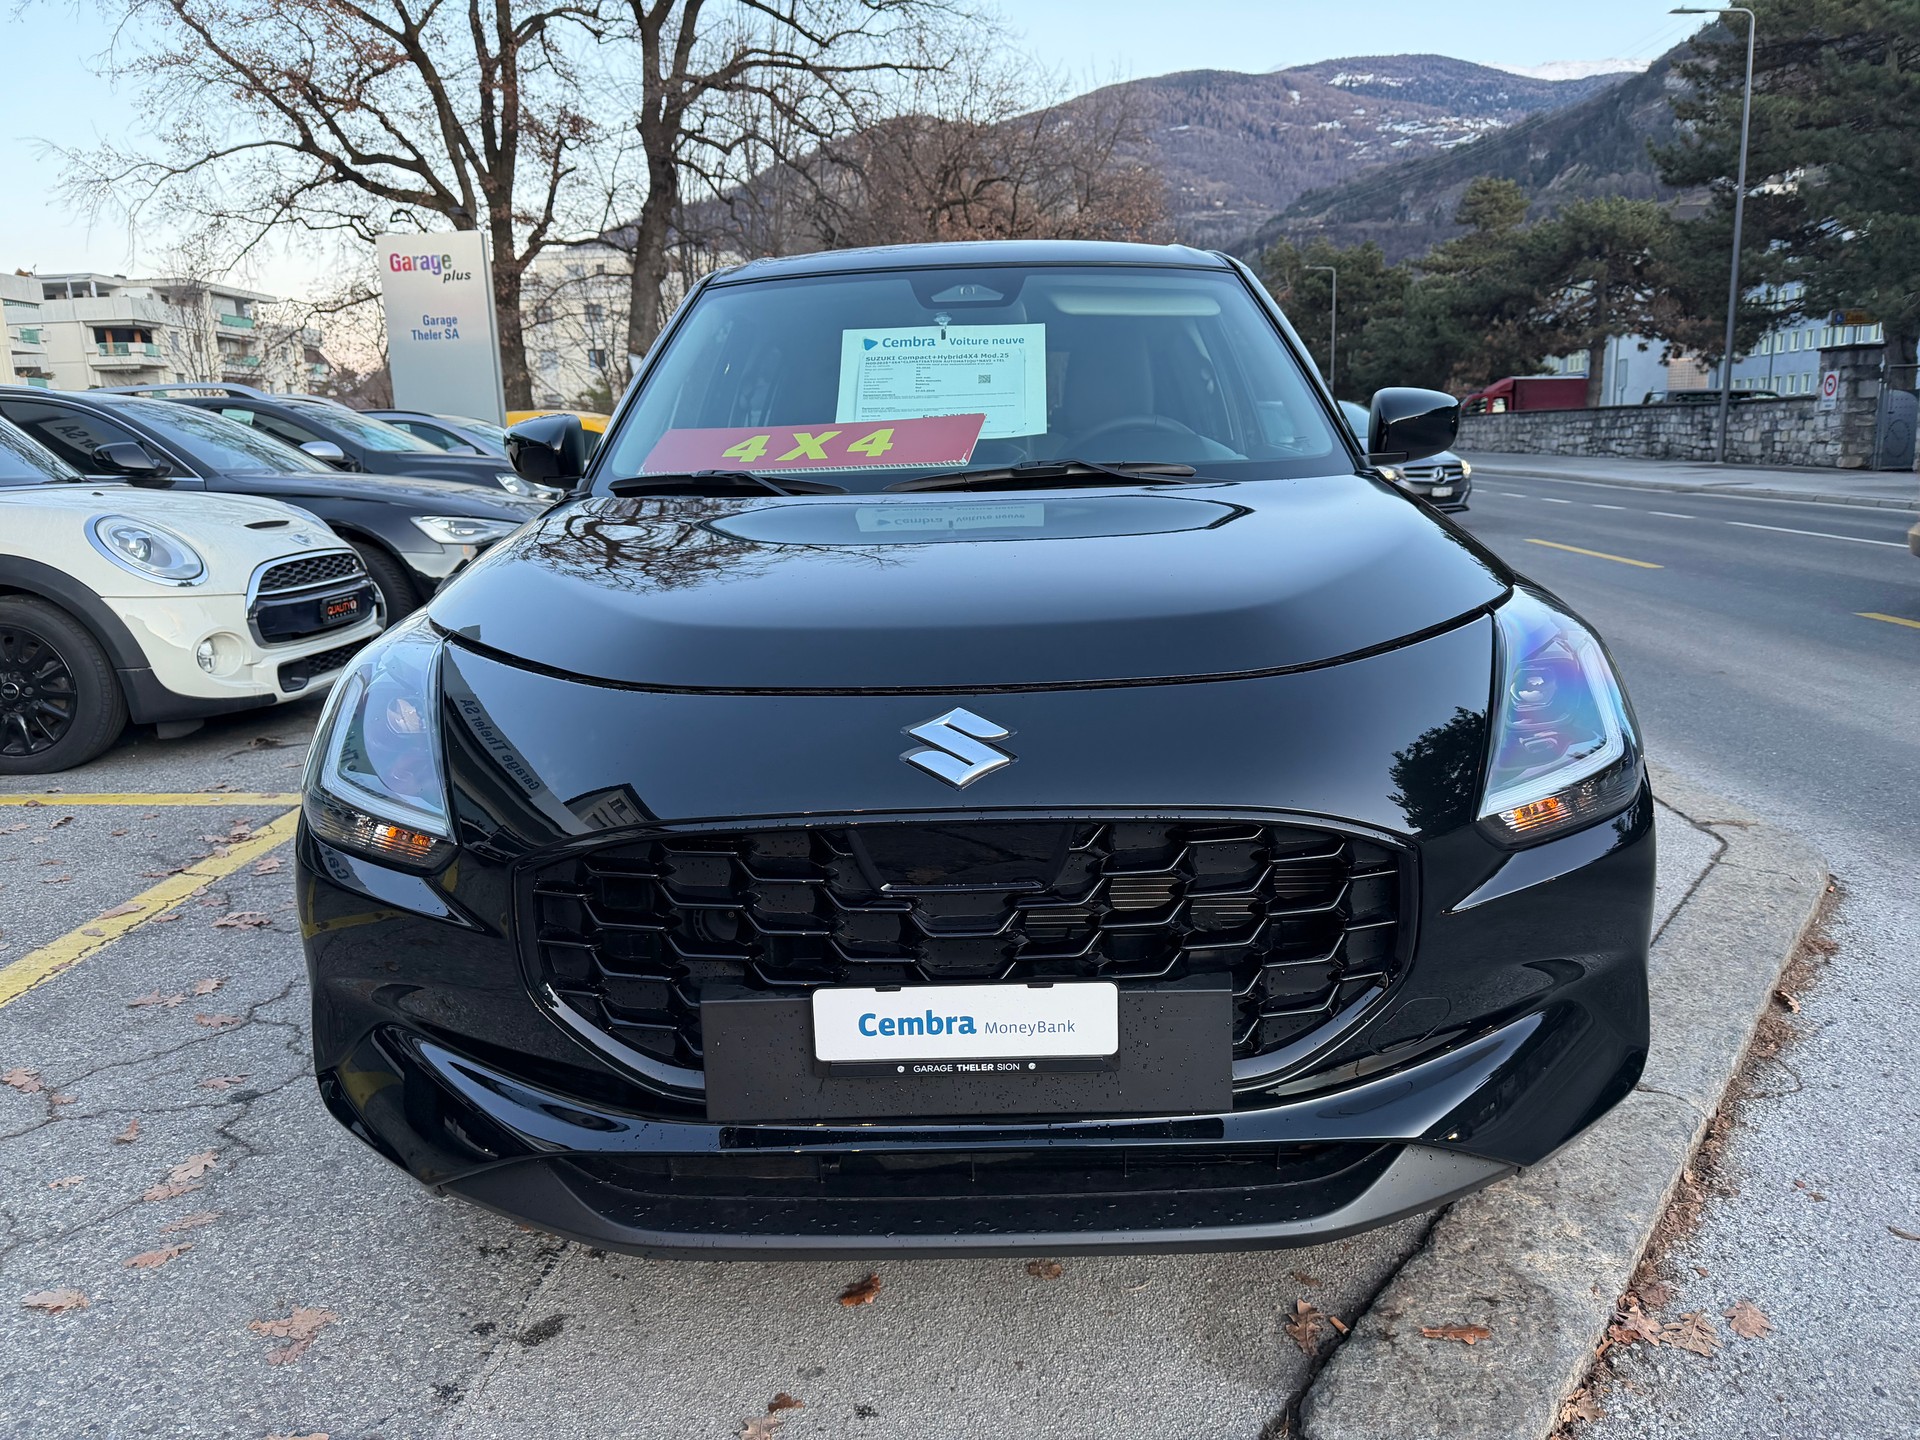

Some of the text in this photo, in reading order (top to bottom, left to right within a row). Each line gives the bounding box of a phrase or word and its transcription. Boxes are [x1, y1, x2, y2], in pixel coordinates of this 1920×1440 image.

[389, 252, 452, 275] Garage
[443, 269, 471, 283] plus
[422, 314, 458, 327] Garage
[411, 328, 460, 341] Theler SA
[882, 336, 1025, 348] Cembra Voiture neuve
[722, 428, 895, 463] 4 X 4
[327, 601, 350, 616] QUALITY
[858, 1009, 1076, 1037] Cembra MoneyBank
[913, 1063, 1020, 1073] GARAGE THELER SION
